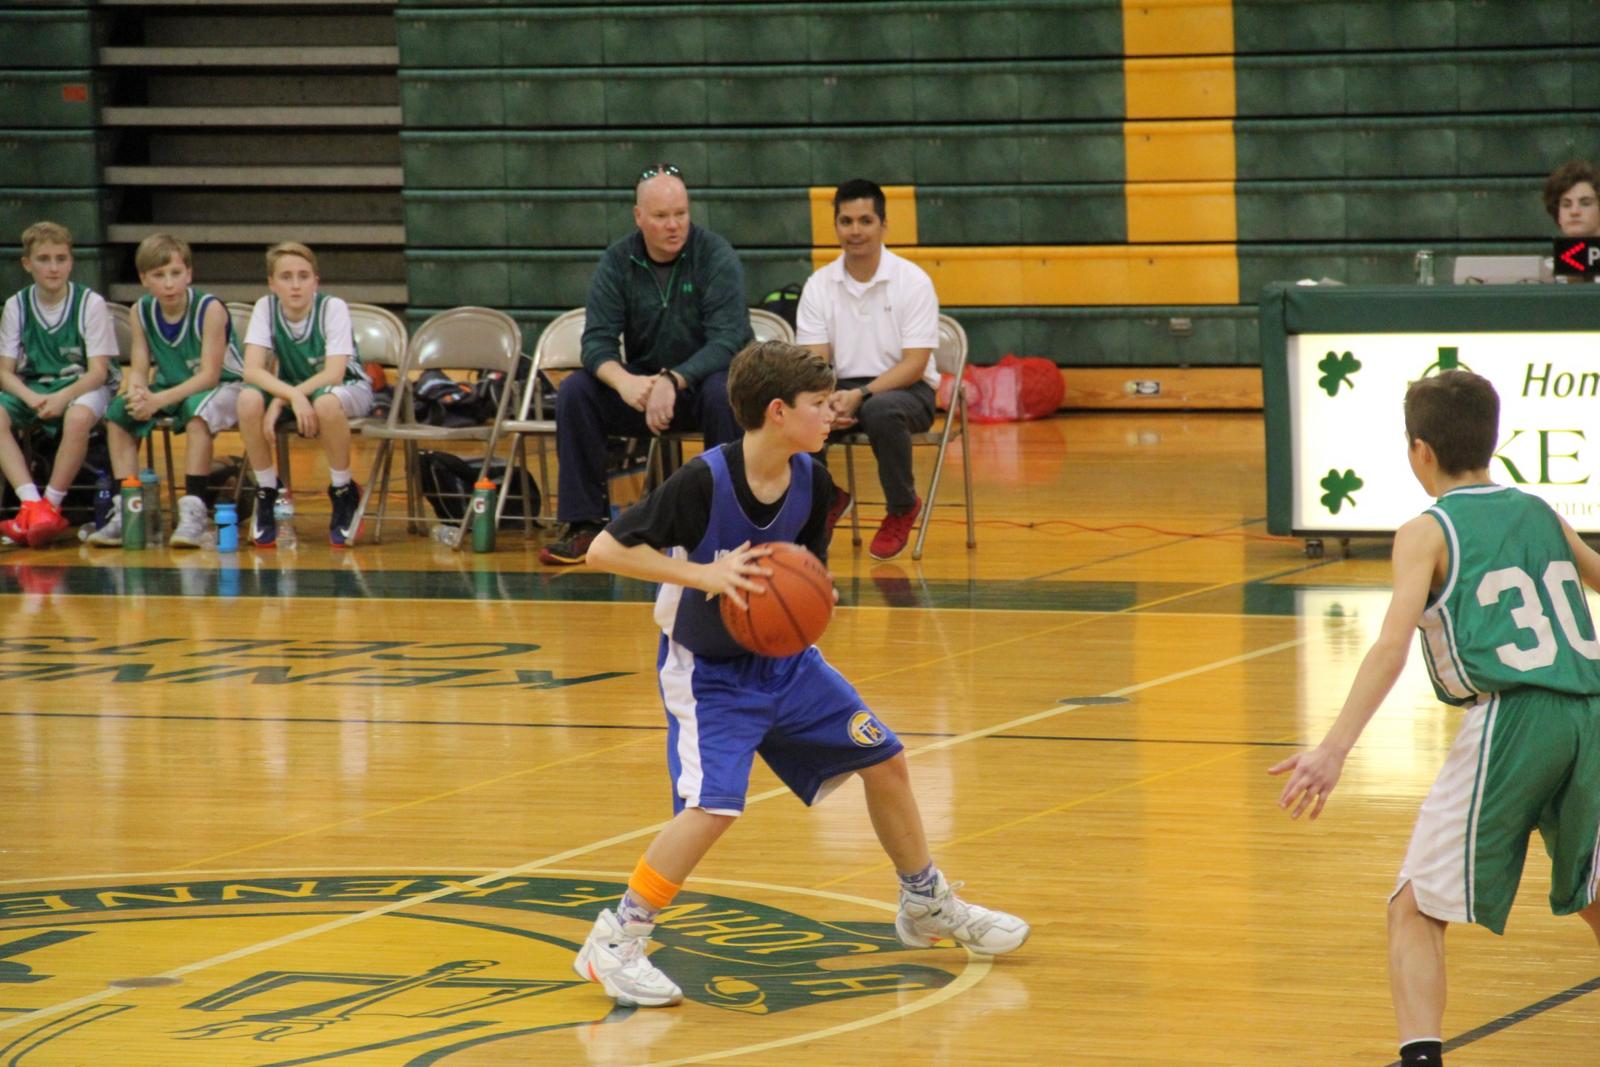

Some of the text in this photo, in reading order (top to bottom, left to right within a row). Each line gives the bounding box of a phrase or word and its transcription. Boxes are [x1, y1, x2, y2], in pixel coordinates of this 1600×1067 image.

[127, 496, 143, 513] G
[473, 497, 487, 514] G
[1476, 561, 1600, 672] 30
[652, 903, 880, 954] JOHN
